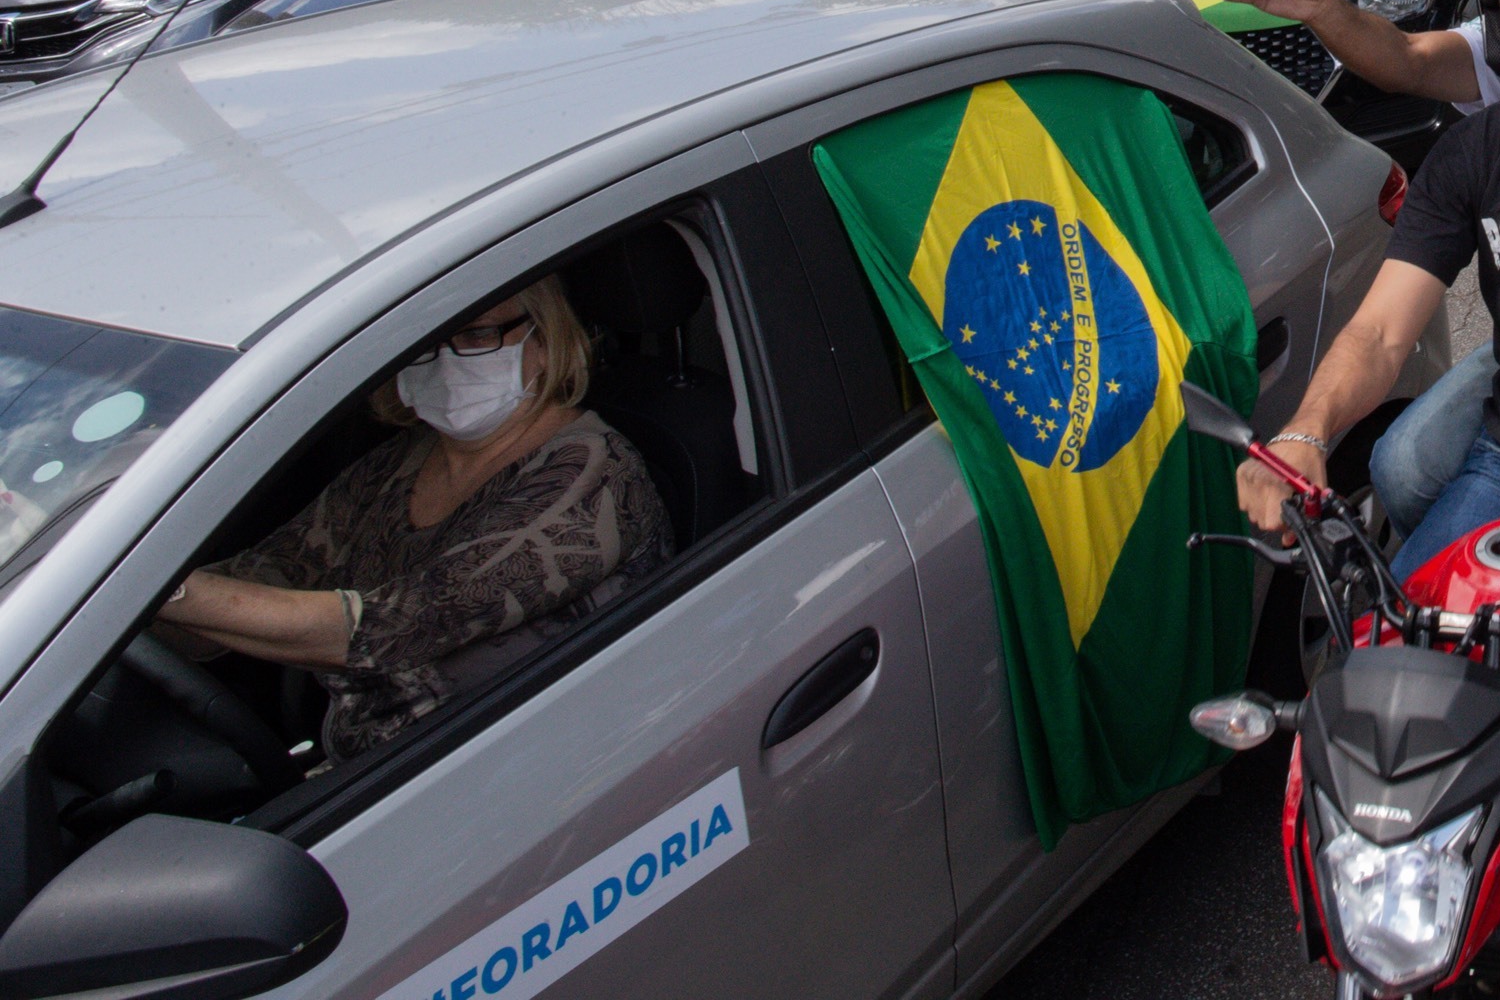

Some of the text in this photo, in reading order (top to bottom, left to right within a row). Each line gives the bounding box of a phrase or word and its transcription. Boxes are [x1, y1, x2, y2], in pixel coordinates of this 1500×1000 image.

[1060, 223, 1093, 468] ORDEM E PROGRESSO
[1353, 802, 1413, 823] HONDA
